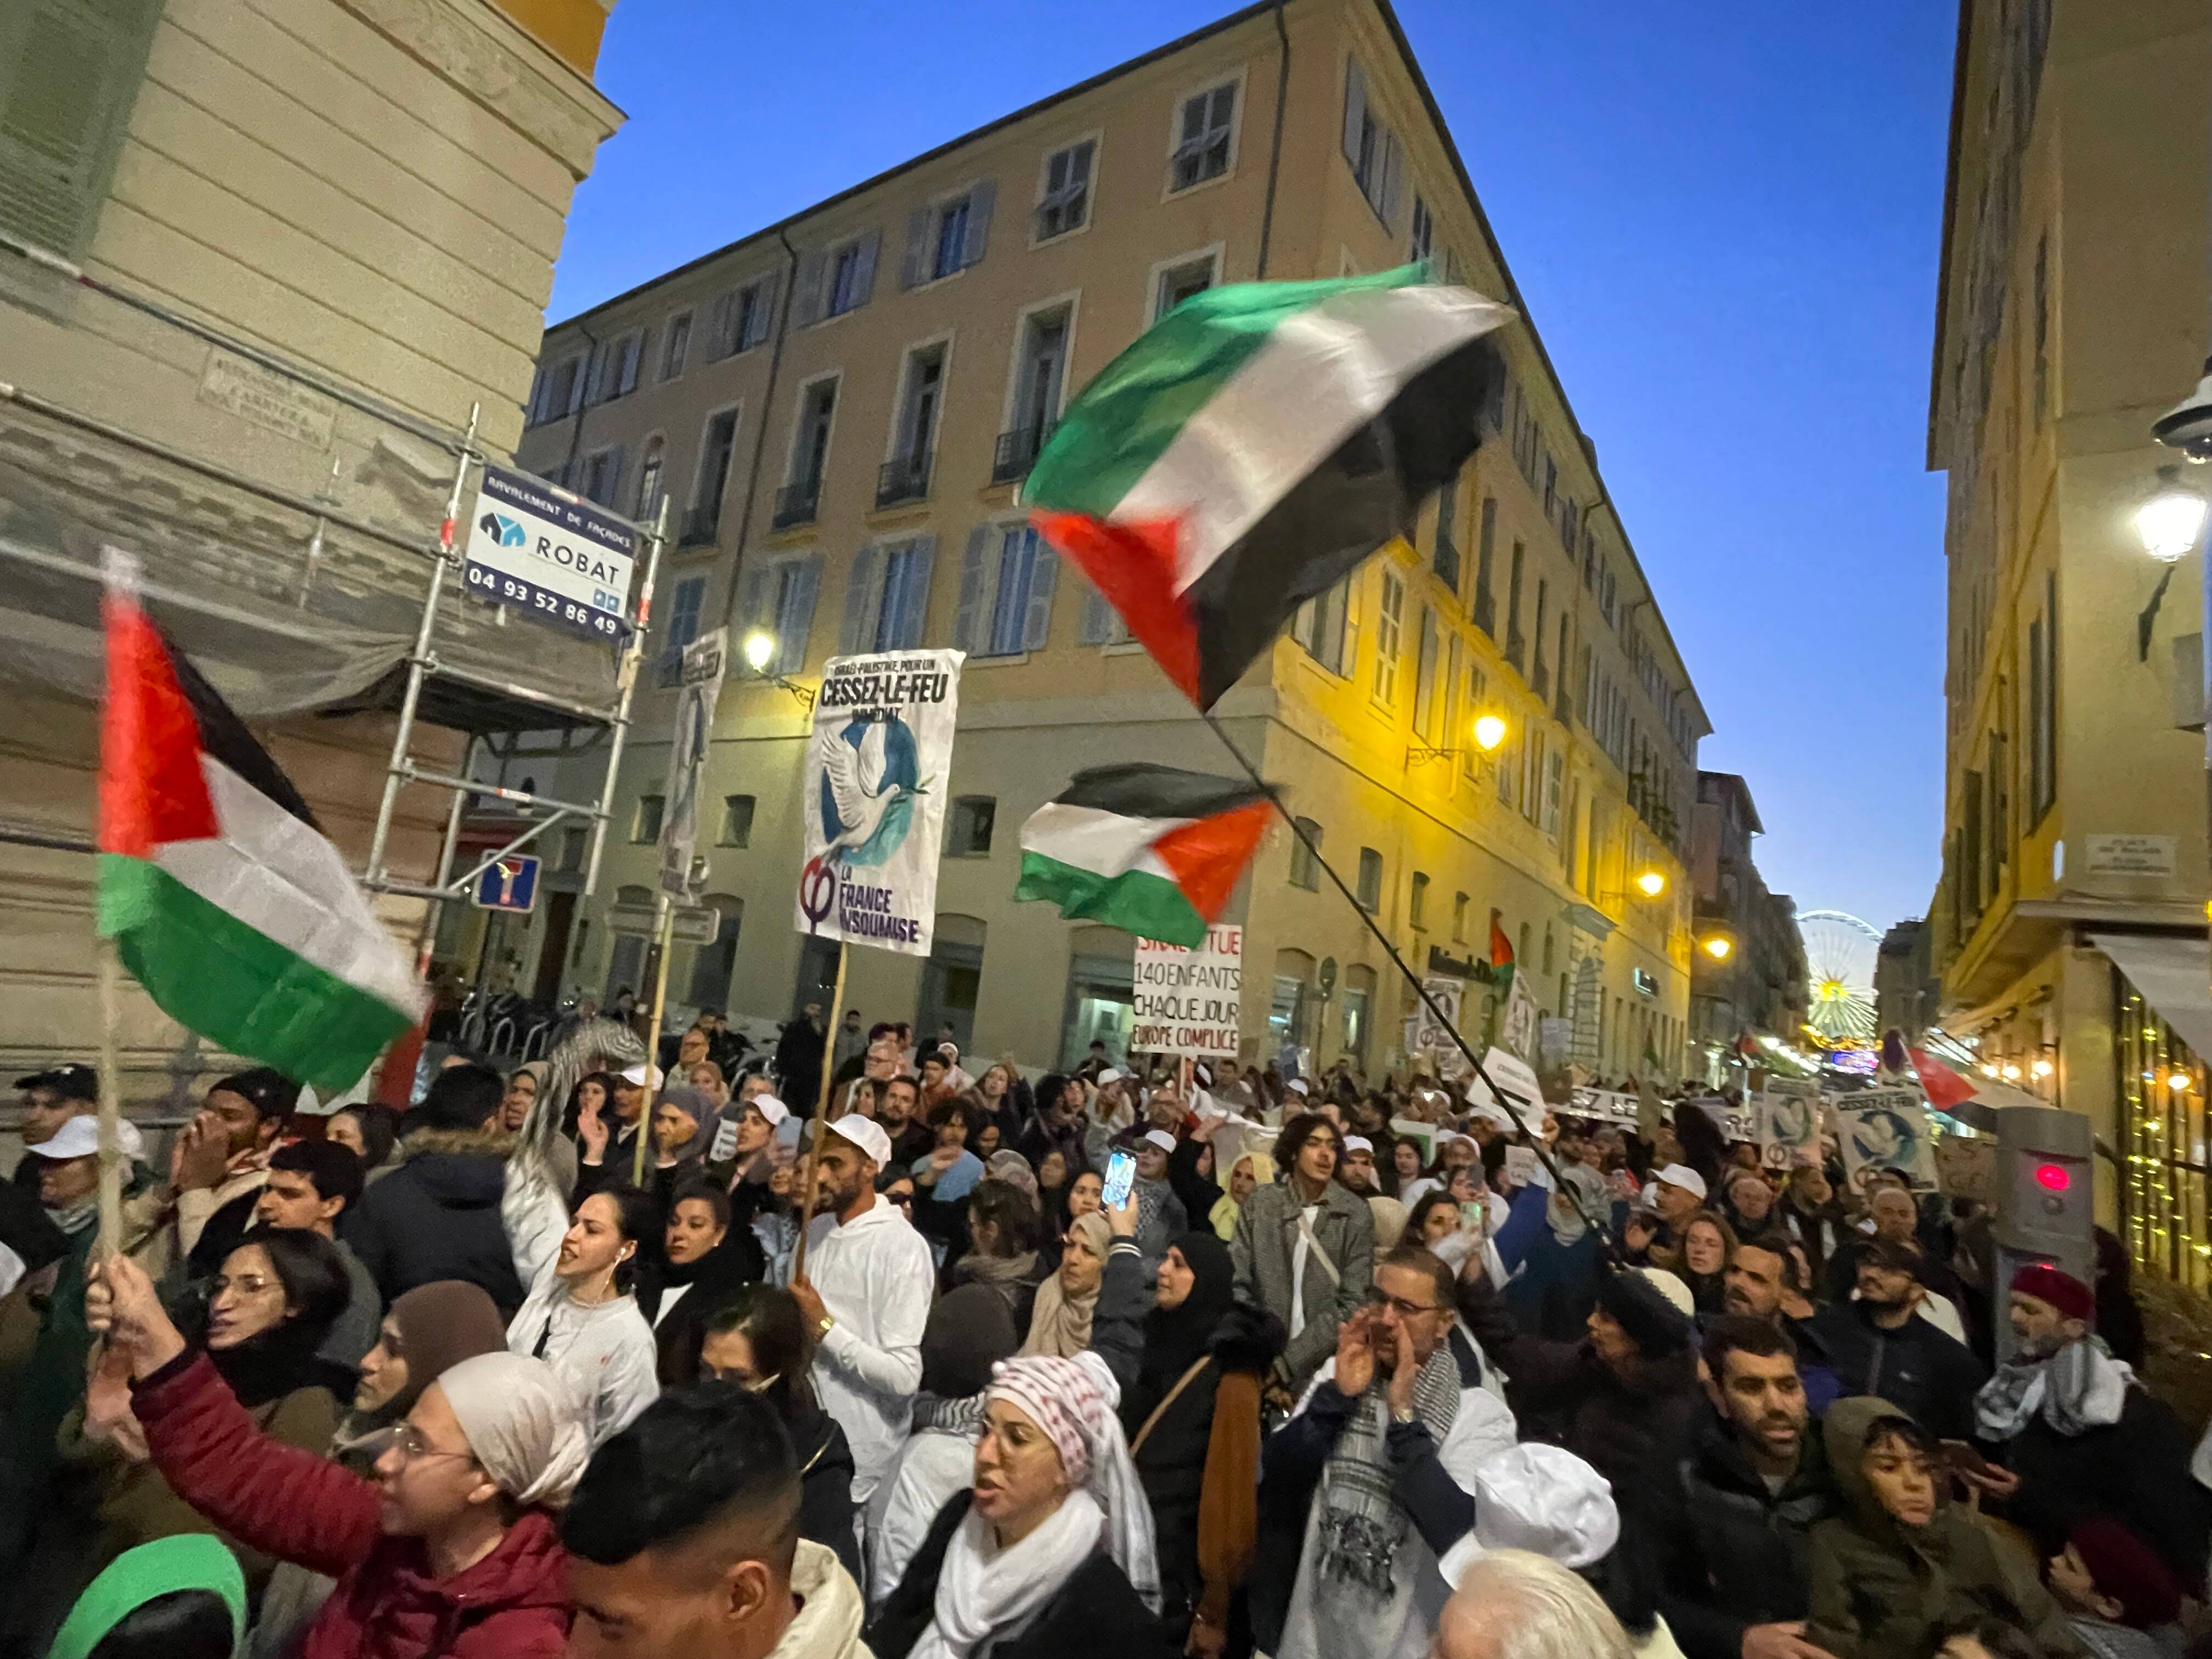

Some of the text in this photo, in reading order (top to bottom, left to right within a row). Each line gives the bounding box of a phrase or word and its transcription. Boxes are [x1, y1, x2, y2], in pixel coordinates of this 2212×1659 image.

[536, 536, 619, 585] ROBAT
[469, 568, 616, 634] 04 93 52 86 49
[821, 673, 949, 707] CESSEZ-LE-FEU
[839, 883, 893, 913] FRANCE
[1207, 930, 1240, 955] TUE
[1133, 994, 1239, 1024] CHAQUE JOUR
[1133, 1024, 1238, 1051] EUROPE COMPLICE
